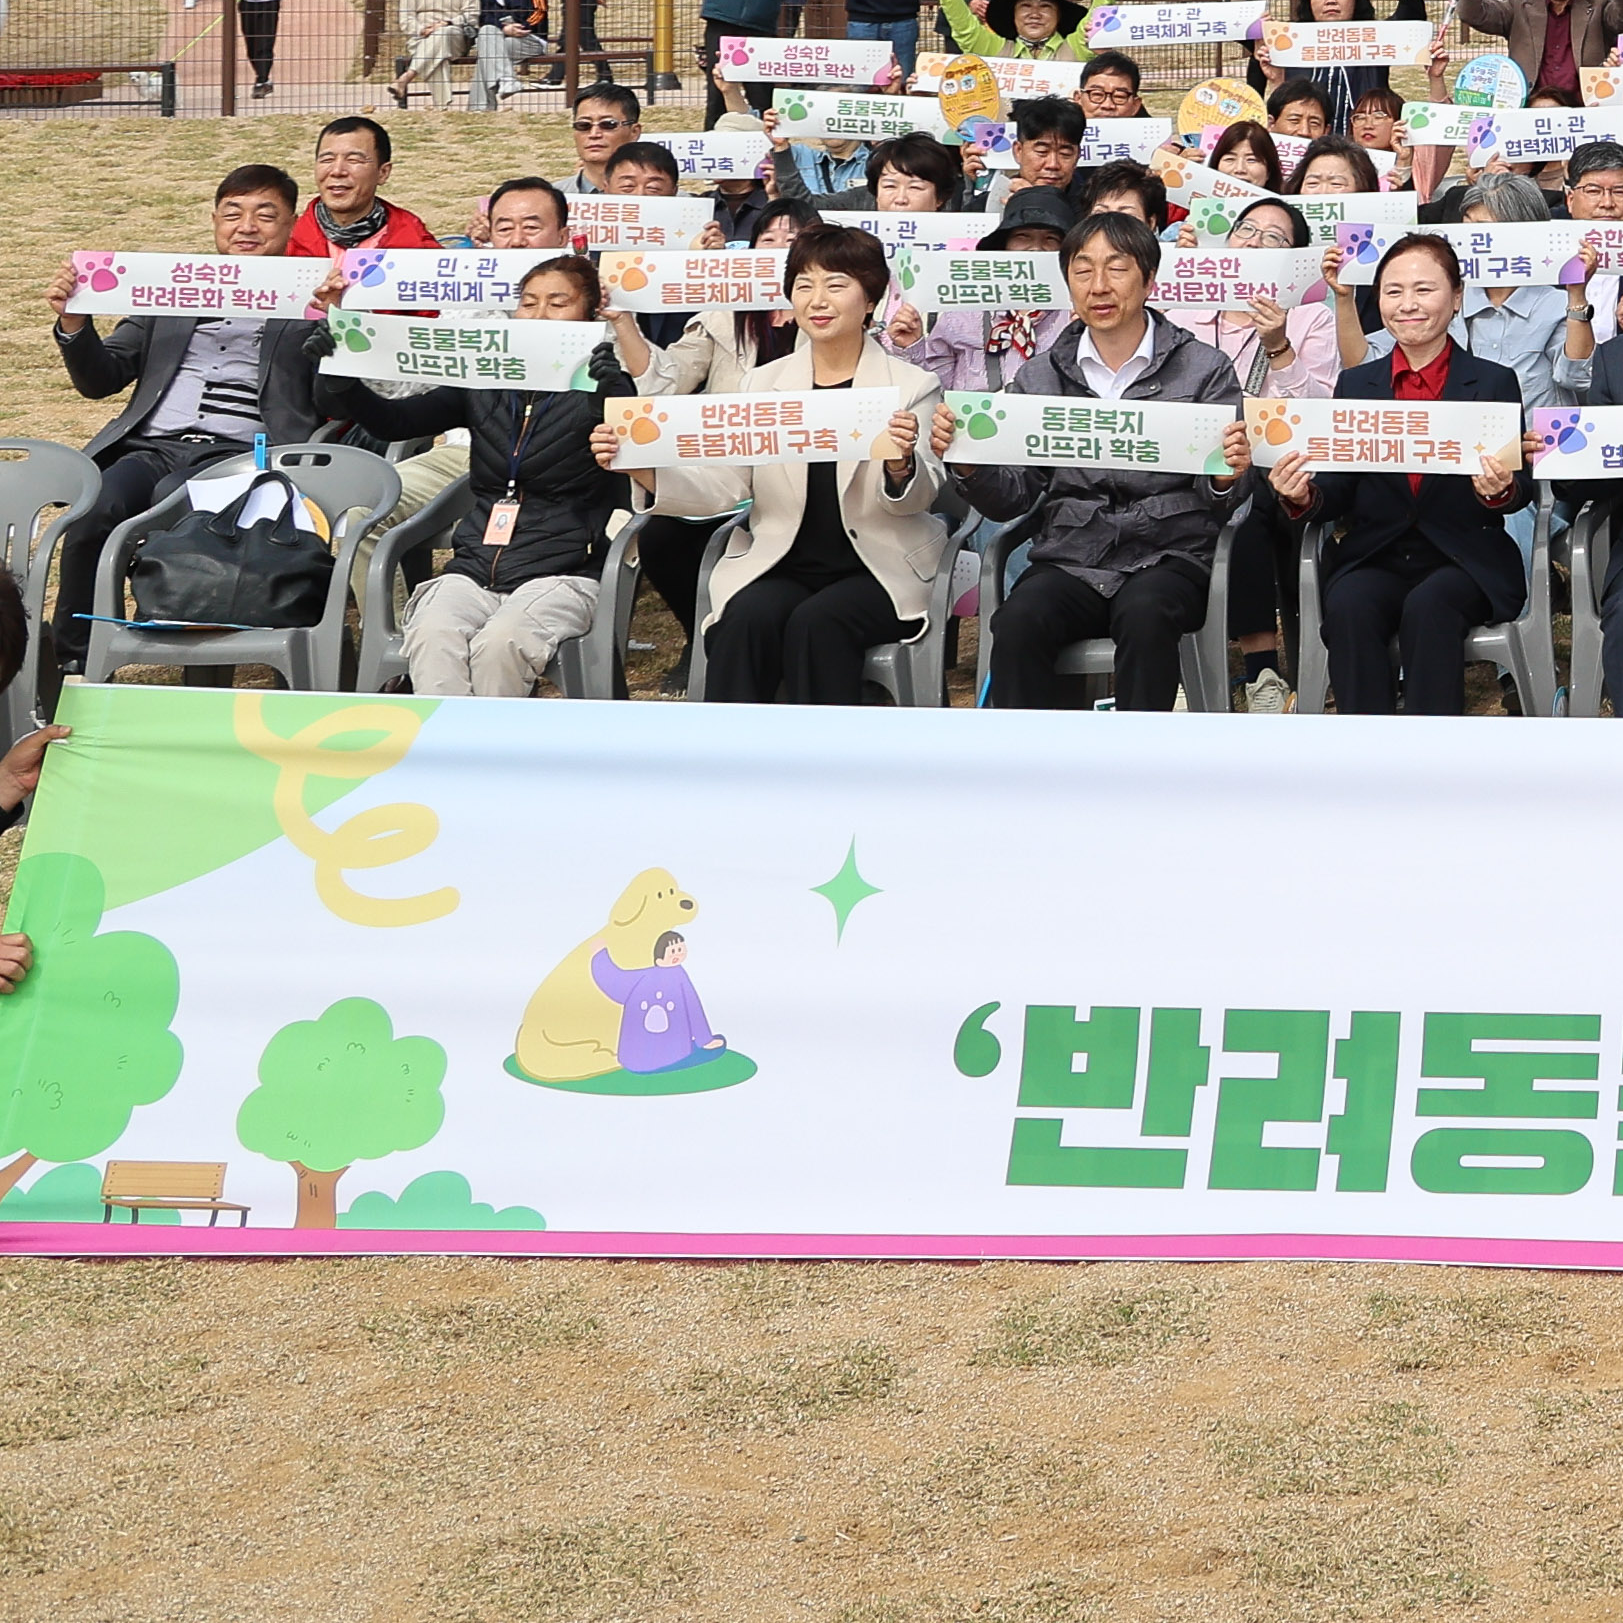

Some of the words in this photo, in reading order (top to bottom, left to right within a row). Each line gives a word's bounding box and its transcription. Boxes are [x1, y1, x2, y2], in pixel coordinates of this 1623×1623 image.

[1197, 21, 1228, 36] 구축
[1316, 27, 1377, 43] 반려동물
[784, 45, 830, 61] 성숙한
[1366, 45, 1397, 60] 구축
[758, 62, 820, 78] 반려문화
[824, 63, 856, 78] 확산
[1019, 79, 1050, 95] 구축
[837, 99, 905, 118] 동물복지
[825, 117, 876, 134] 인프라
[1097, 143, 1131, 160] 구축
[1505, 137, 1576, 157] 협력체계
[701, 157, 734, 174] 구축
[625, 226, 666, 246] 구축
[172, 261, 242, 285] 성숙한
[685, 257, 776, 279] 반려동물
[949, 260, 1036, 281] 동물복지
[1174, 257, 1241, 279] 성숙한
[1488, 257, 1532, 278] 구축
[131, 287, 225, 310] 반려문화
[232, 289, 279, 310] 확산
[396, 280, 484, 302] 협력체계
[660, 282, 753, 303] 돌봄체계
[937, 283, 1003, 304] 인프라
[1010, 282, 1052, 303] 확충
[408, 328, 509, 355] 동물복지
[396, 352, 468, 378] 인프라
[475, 355, 527, 381] 확충
[701, 401, 804, 429] 반려동물
[1041, 407, 1144, 435] 동물복지
[1332, 409, 1430, 436] 반려동물
[676, 431, 780, 459] 돌봄체계
[787, 429, 839, 454] 구축
[1024, 434, 1103, 460] 인프라
[1110, 438, 1161, 464] 확충
[1307, 437, 1405, 464] 돌봄체계
[1412, 439, 1463, 464] 구축
